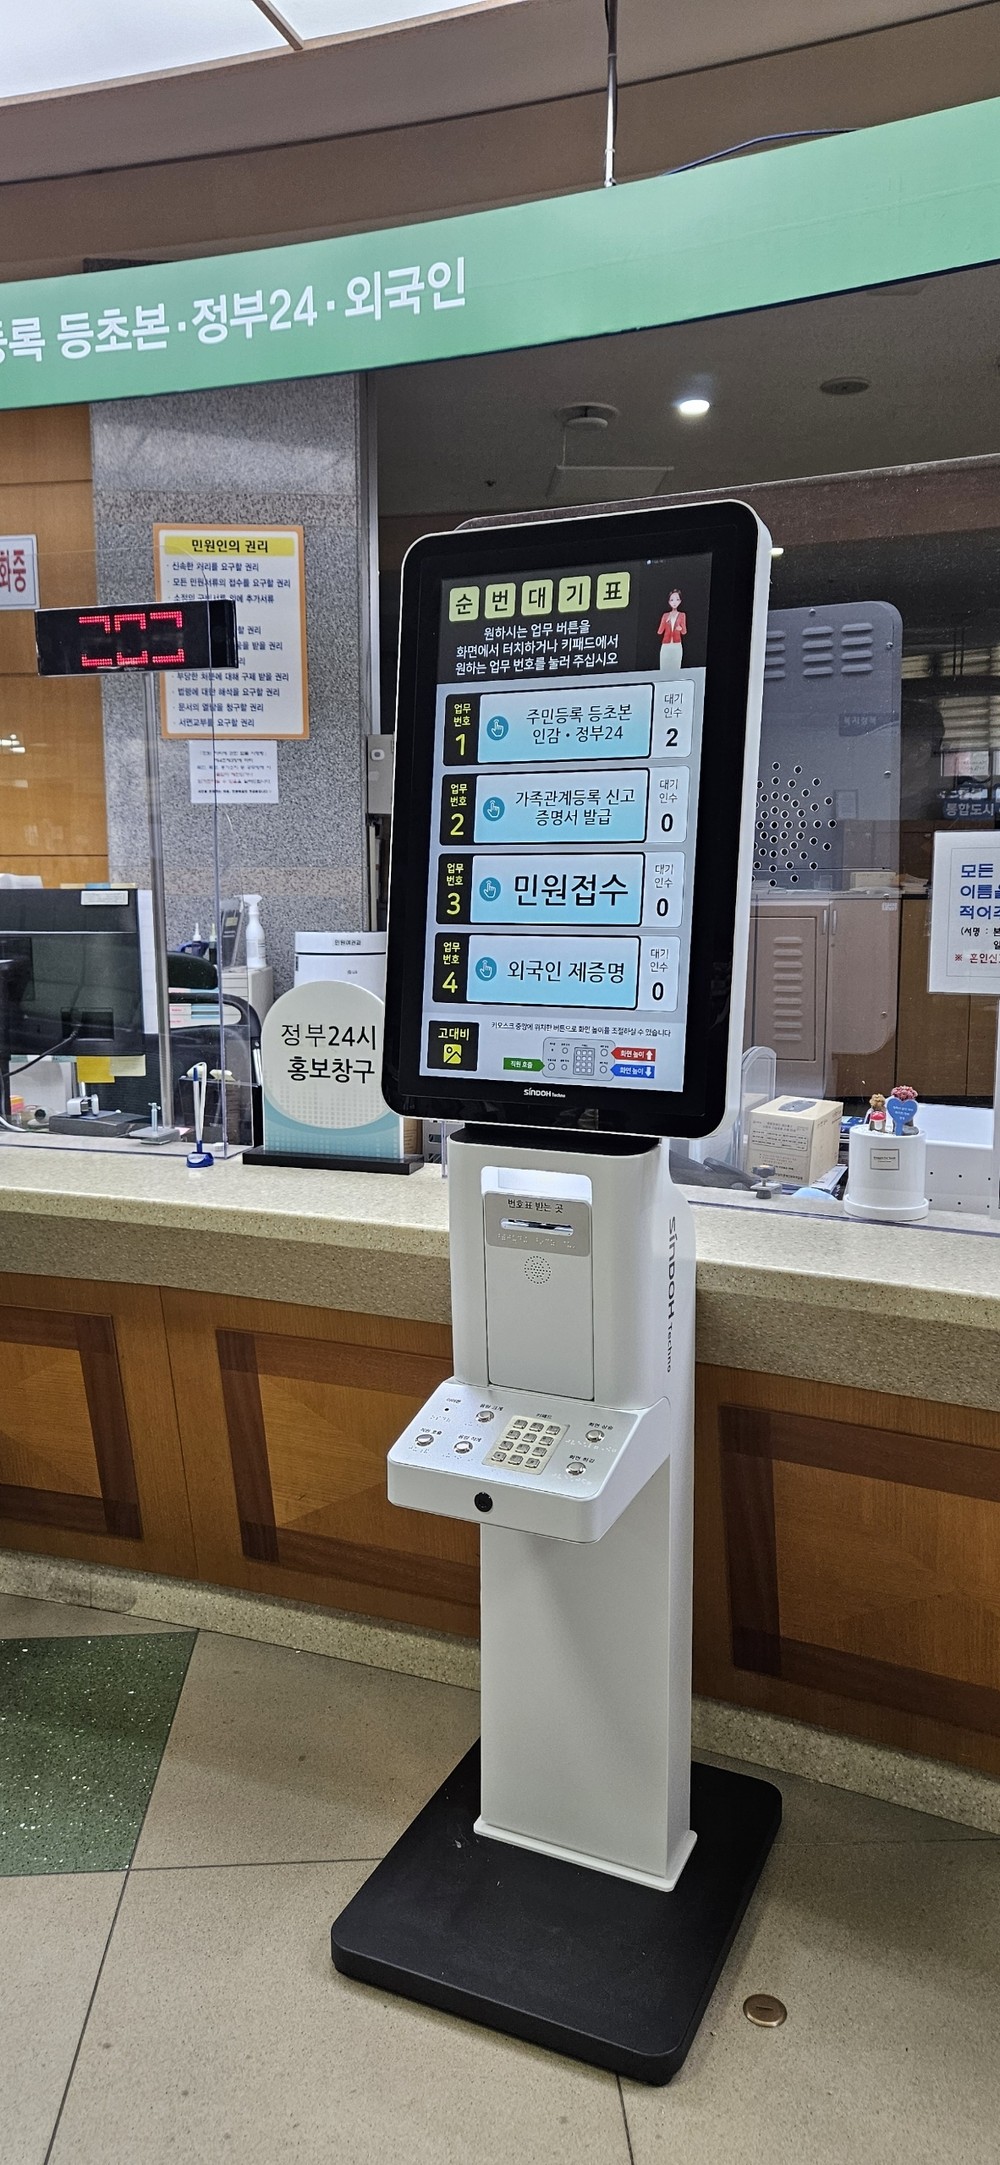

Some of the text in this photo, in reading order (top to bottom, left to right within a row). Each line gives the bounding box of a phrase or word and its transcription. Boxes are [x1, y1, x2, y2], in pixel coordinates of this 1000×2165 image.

[192, 539, 268, 553] 민원인의 권리
[172, 562, 259, 572] 신속한 처리를 요구할 권리
[173, 578, 291, 588] 모든 민원서류의 접수를 요구할 권리
[248, 626, 261, 634] 권리
[483, 619, 590, 641] 원하시는 업무 버튼을
[252, 642, 266, 650] 받을
[269, 642, 283, 651] 권리
[456, 634, 619, 659] 화면에서 터치하거나 키패드에서
[455, 652, 618, 676] 원하는 업무 번호를 눌러 주십시오
[242, 672, 256, 681] 구제
[259, 672, 272, 681] 받을
[275, 672, 289, 681] 권리
[201, 688, 216, 696] 대한
[219, 688, 239, 696] 해석을
[242, 688, 264, 696] 요구할
[266, 688, 280, 697] 권리
[664, 693, 683, 704] 대기
[178, 703, 199, 712] 문서의
[226, 703, 247, 712] 청구할
[250, 703, 264, 712] 권리
[454, 703, 471, 714] 업무
[664, 706, 682, 719] 인수
[526, 703, 633, 726] 주민등록 등초본
[217, 719, 238, 727] 요구할
[241, 719, 255, 727] 권리
[453, 716, 471, 727] 번호
[665, 728, 678, 747] 2
[455, 733, 466, 756] 1
[450, 783, 468, 794] 업무
[659, 779, 679, 790] 대기
[450, 795, 467, 806] 번호
[515, 788, 635, 807] 가족관계등록 신고
[659, 792, 678, 804] 인수
[535, 808, 612, 826] 증명서 발급
[661, 813, 673, 832] 0
[451, 813, 464, 836] 2
[447, 863, 464, 874] 업무
[654, 864, 674, 875] 대기
[961, 864, 994, 878] 모든
[446, 875, 464, 886] 번호
[654, 877, 673, 889] 인수
[514, 874, 629, 907] 민원접수
[446, 892, 461, 915] 3
[656, 898, 669, 917] 0
[443, 941, 461, 952] 업무
[442, 954, 460, 964] 번호
[650, 948, 669, 959] 대기
[969, 953, 1000, 964] 혼인신
[507, 960, 625, 983] 외국인 제증명
[650, 961, 669, 973] 인수
[441, 971, 458, 994] 4
[652, 981, 664, 1001] 0
[438, 1027, 470, 1041] 고대비
[491, 1022, 515, 1030] 키오스크
[553, 1024, 577, 1032] 버튼으로
[645, 1028, 671, 1037] 있습니다
[281, 1024, 376, 1050] 정부24시
[620, 1050, 645, 1059] 화면 높이
[287, 1056, 375, 1084] 홍보창구
[619, 1066, 644, 1075] 화면 높이
[507, 1199, 563, 1213] 번호표 받는 곳
